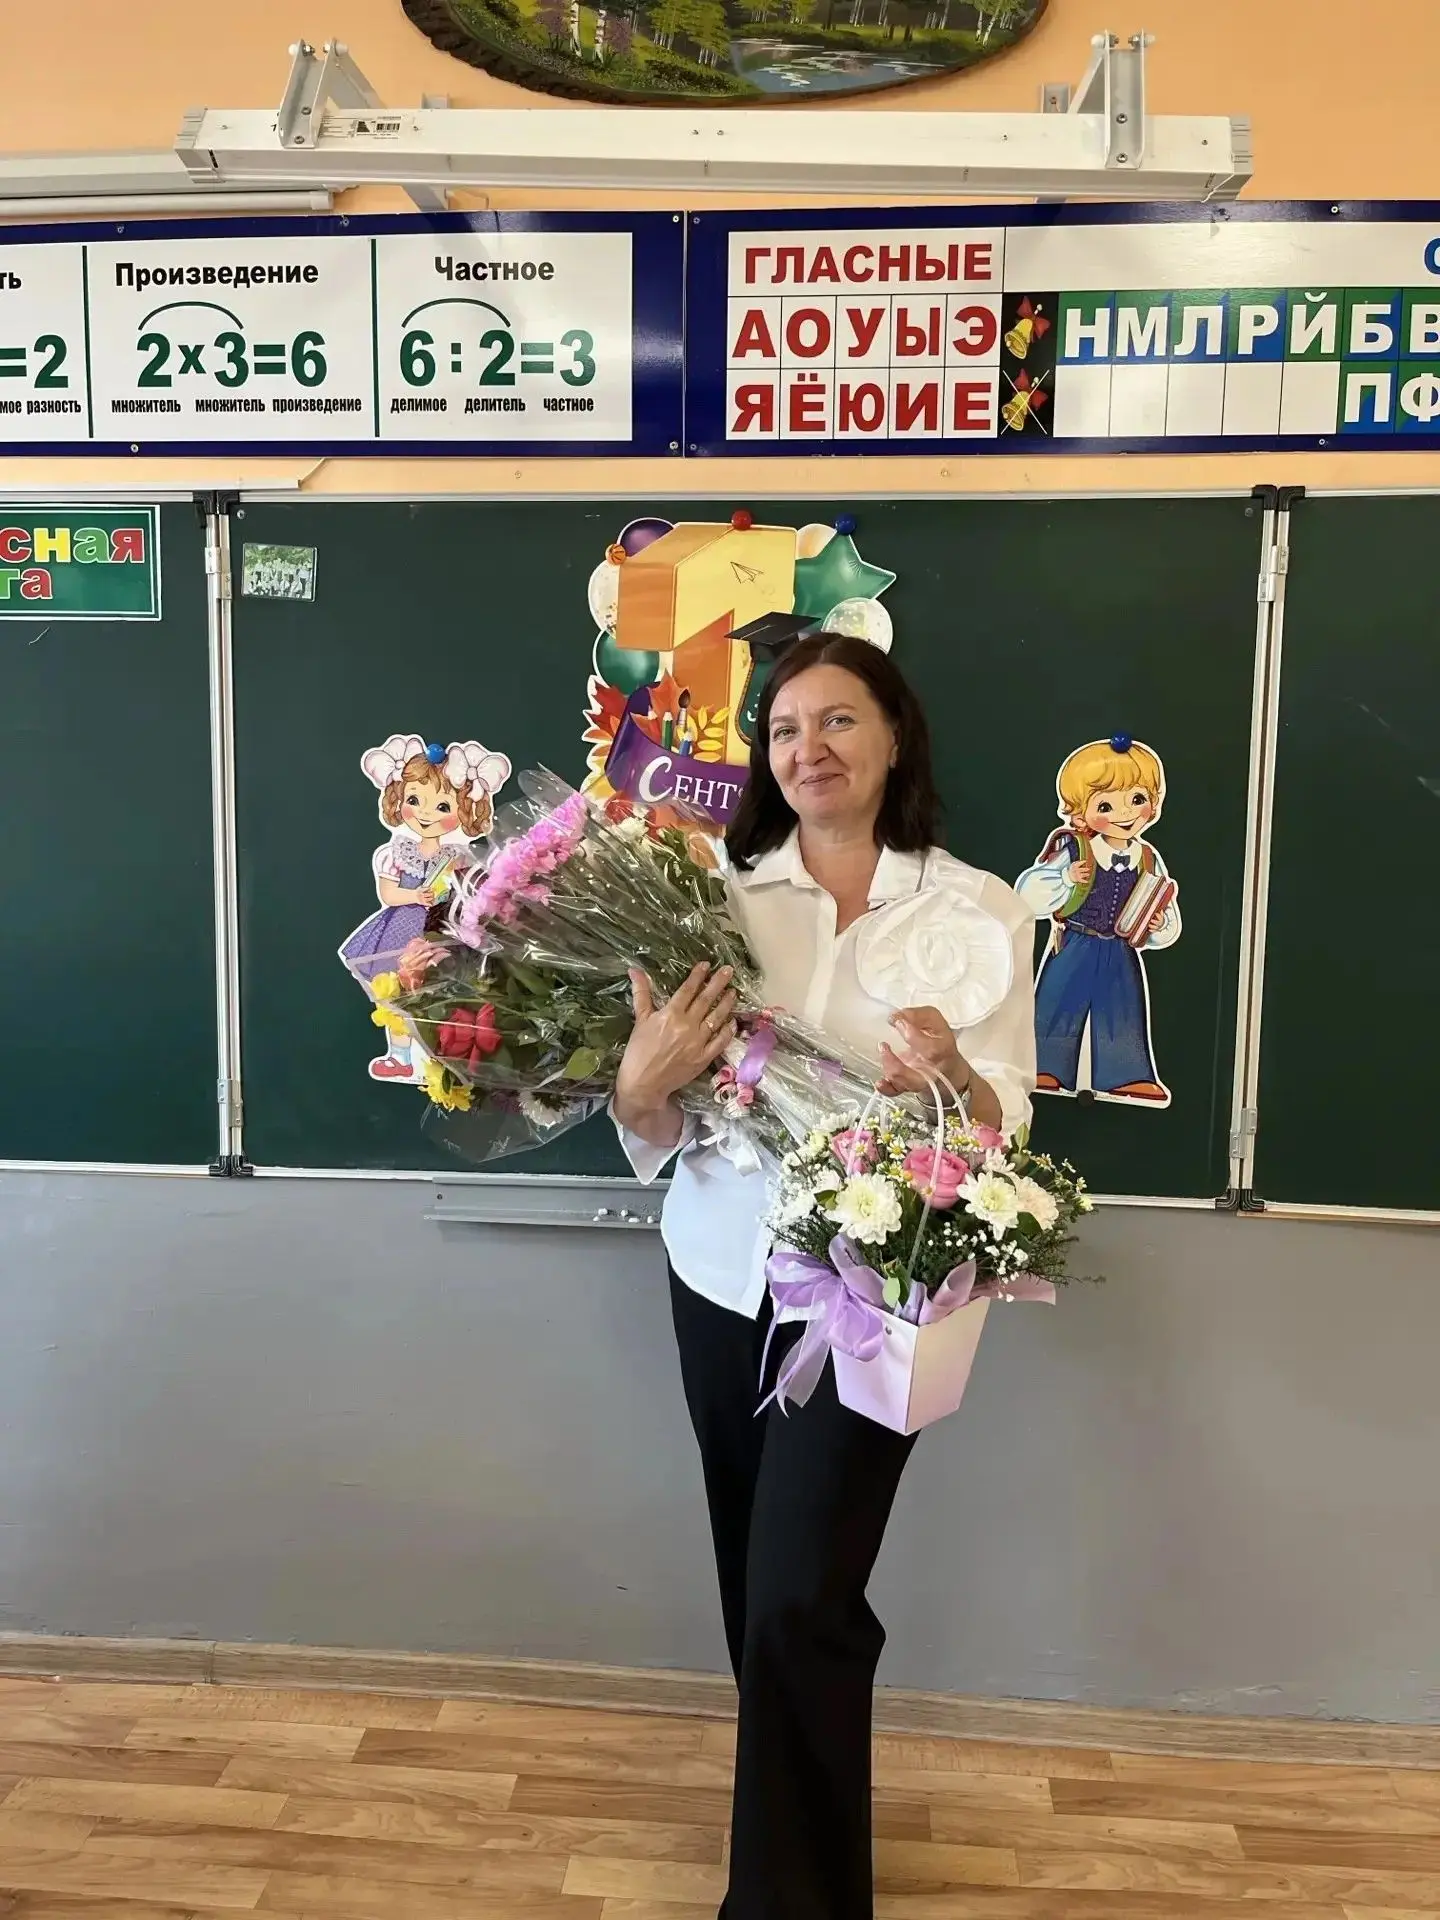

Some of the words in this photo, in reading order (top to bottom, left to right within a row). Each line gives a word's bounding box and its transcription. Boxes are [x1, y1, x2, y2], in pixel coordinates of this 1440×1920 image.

[434, 256, 555, 281] Частное
[744, 243, 993, 284] ГЛАСНЫЕ
[115, 262, 319, 292] Произведение
[27, 400, 82, 415] разность
[111, 399, 182, 413] множитель
[195, 398, 266, 413] множитель
[272, 397, 362, 414] произведение
[390, 397, 448, 414] делимое
[464, 397, 526, 414] делитель
[543, 397, 595, 413] частное
